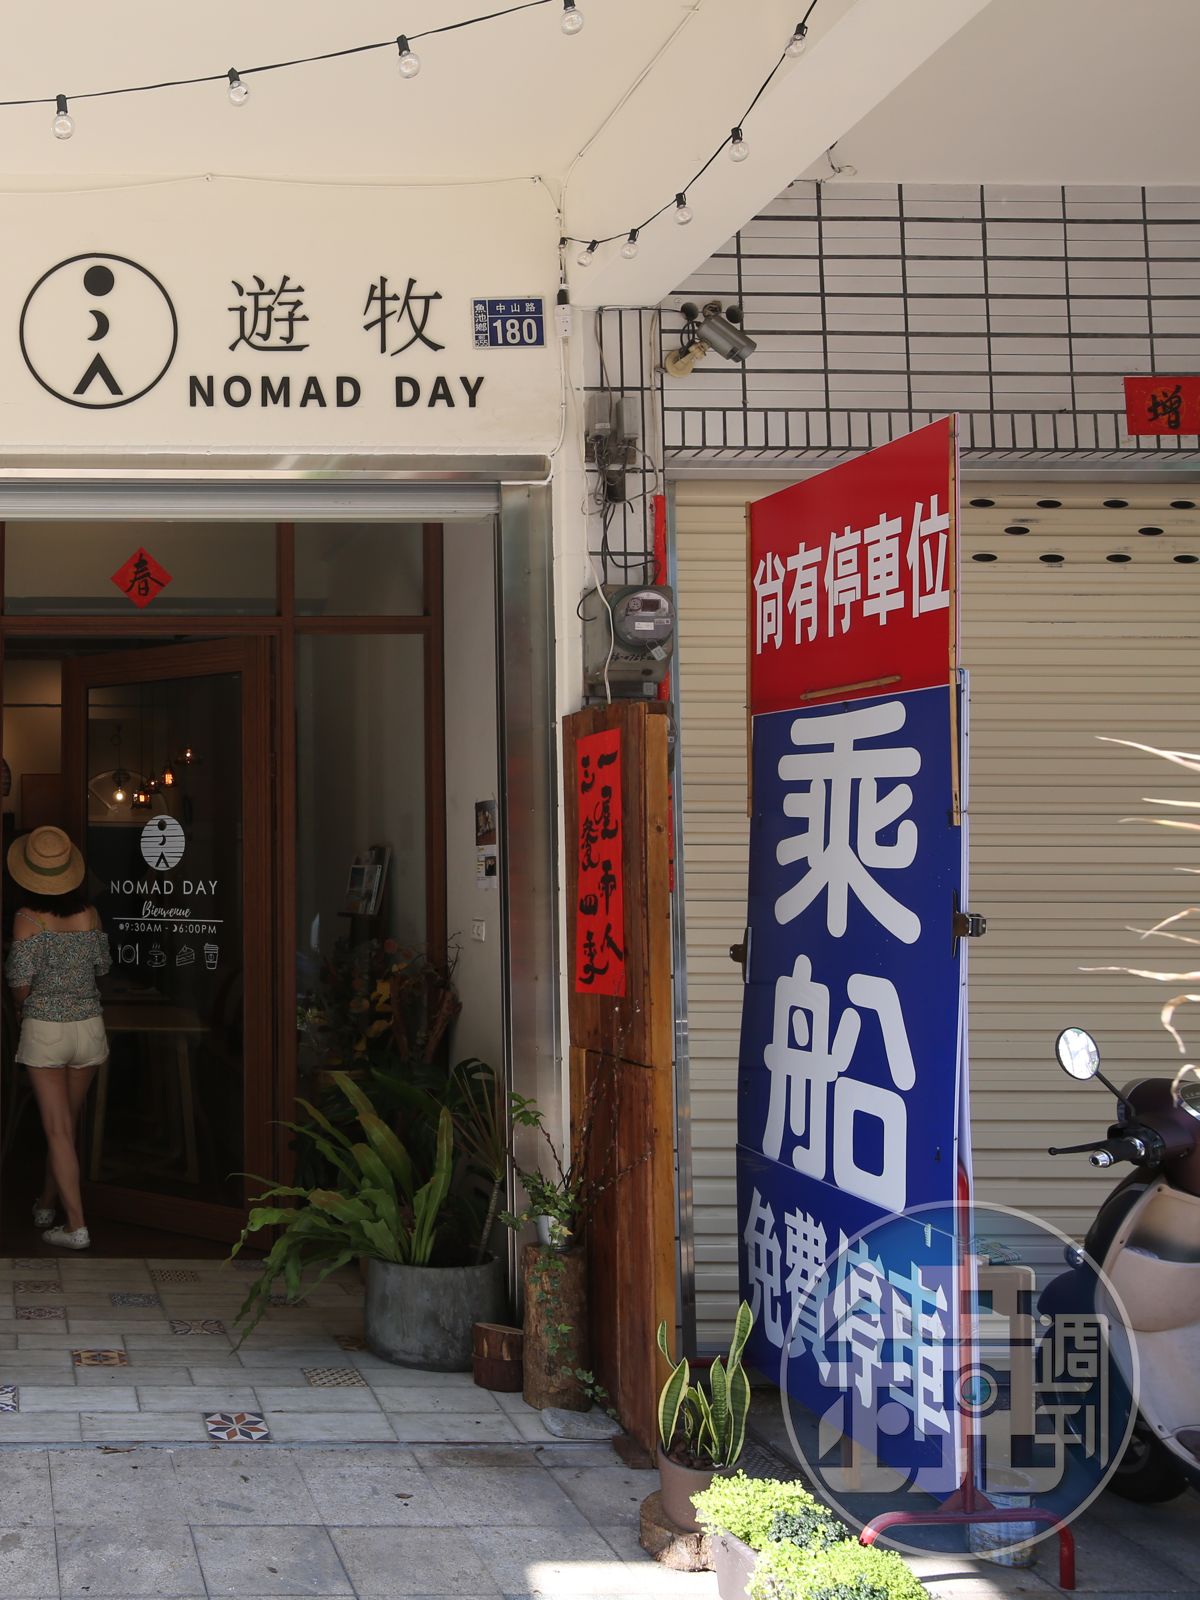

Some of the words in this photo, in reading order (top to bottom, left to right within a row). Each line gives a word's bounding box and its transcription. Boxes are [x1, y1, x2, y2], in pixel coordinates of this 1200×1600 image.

[228, 275, 445, 356] 遊牧
[475, 303, 487, 332] 魚池鄉
[495, 302, 536, 313] 中山路
[492, 318, 537, 344] 180
[189, 375, 362, 408] NOMAD
[395, 375, 485, 408] DAY
[124, 552, 166, 596] 春
[753, 493, 950, 655] 尚有停車位
[110, 880, 174, 895] NOMAD
[183, 880, 218, 895] DAY
[142, 900, 192, 919] Bienvenue
[125, 922, 162, 933] 9:30AM
[178, 924, 217, 934] 6:00PM
[762, 701, 922, 1213] 乘船
[743, 1186, 951, 1443] 免費停車
